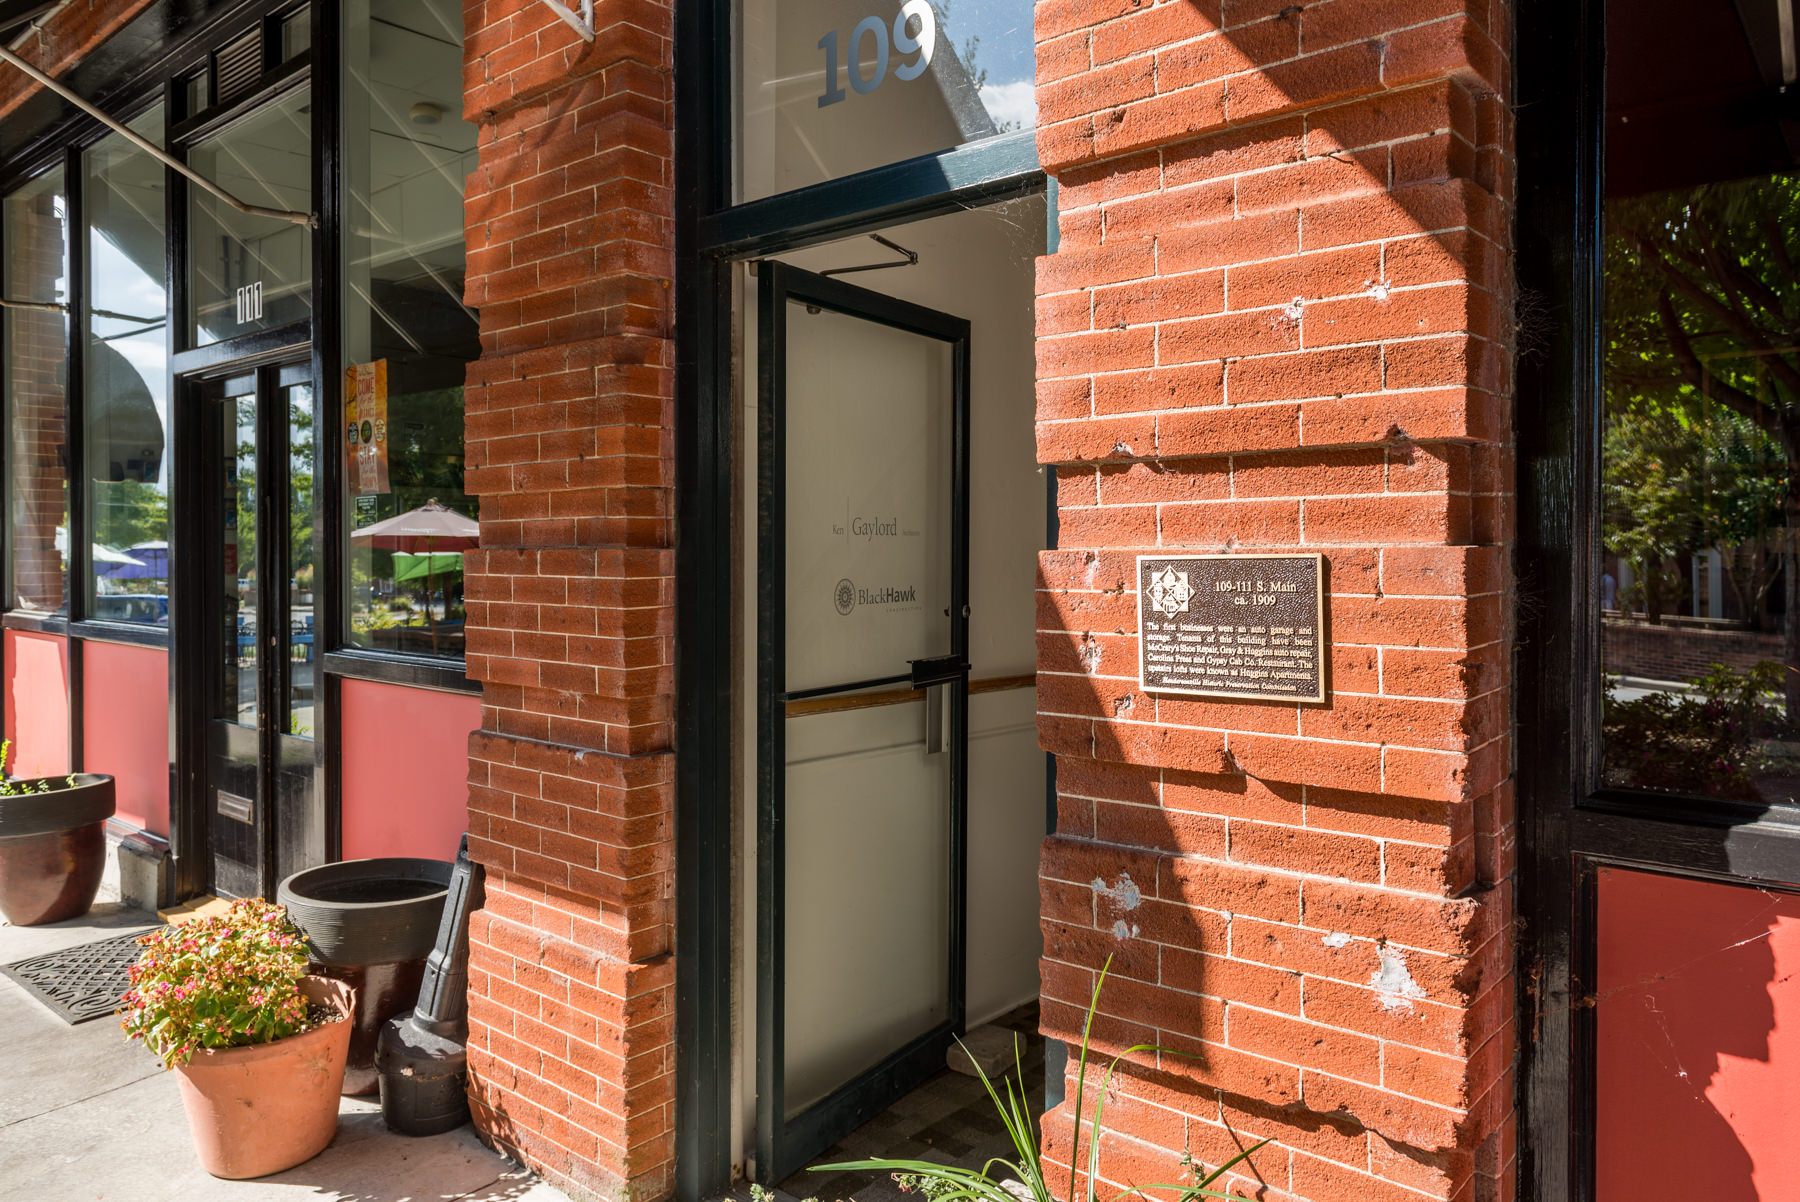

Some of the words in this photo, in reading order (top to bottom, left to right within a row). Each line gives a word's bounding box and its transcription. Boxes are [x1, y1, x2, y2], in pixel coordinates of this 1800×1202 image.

[817, 0, 936, 108] 109
[237, 281, 262, 325] 111
[358, 376, 375, 396] COME
[359, 446, 375, 465] STAY
[832, 524, 845, 535] Ken
[852, 516, 897, 542] Gaylord
[858, 585, 916, 605] BlackHawk
[1216, 580, 1252, 592] 109-111
[1257, 581, 1267, 592] S.
[1270, 581, 1298, 593] Main
[1234, 596, 1248, 605] ca.
[1253, 594, 1277, 606] 1909
[1146, 622, 1160, 631] The
[1163, 623, 1177, 631] first
[1180, 623, 1214, 632] businesses
[1218, 625, 1234, 633] were
[1250, 626, 1266, 634] auto
[1270, 627, 1295, 636] garage
[1298, 626, 1313, 635] and
[1147, 633, 1172, 643] storage.
[1176, 633, 1202, 642] Tenants
[1206, 634, 1216, 643] of
[1219, 633, 1233, 643] this
[1237, 635, 1267, 646] building
[1272, 637, 1290, 646] have
[1294, 637, 1313, 647] been
[1180, 643, 1196, 653] Shoe
[1237, 647, 1243, 655] &
[1244, 646, 1273, 658] Huggins
[1274, 648, 1289, 657] auto
[1290, 649, 1313, 660] repair,
[1147, 653, 1174, 662] Carolina
[1175, 655, 1192, 663] Press
[1193, 655, 1206, 664] and
[1206, 656, 1228, 667] Gypsy
[1229, 657, 1243, 666] Cab
[1244, 658, 1257, 667] Co.
[1258, 659, 1297, 669] Restaurant.
[1298, 660, 1314, 670] The
[1189, 666, 1206, 675] were
[1206, 666, 1229, 676] known
[1240, 668, 1269, 679] Huggins
[1270, 670, 1313, 681] Apartments.
